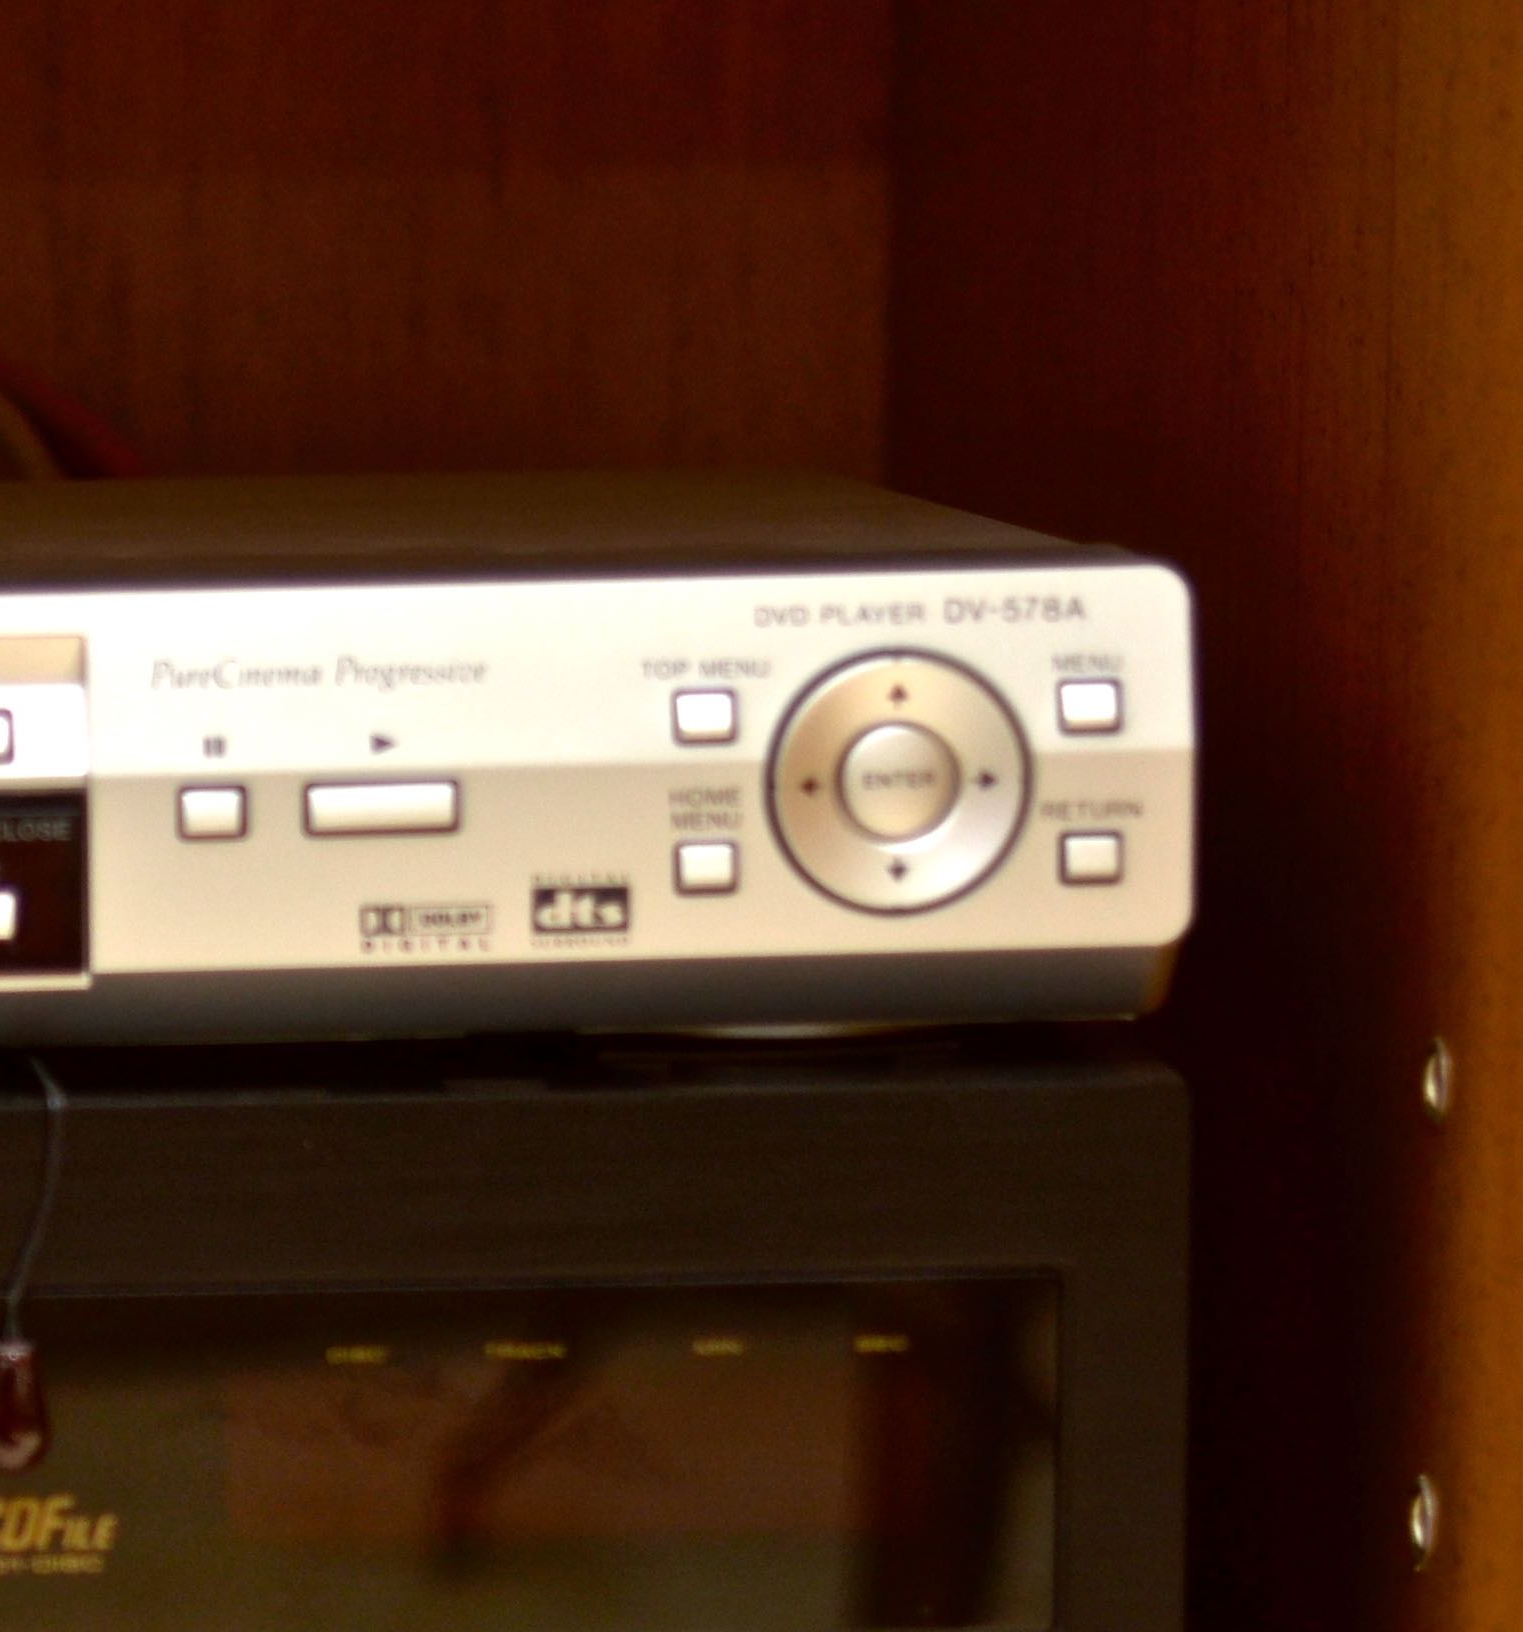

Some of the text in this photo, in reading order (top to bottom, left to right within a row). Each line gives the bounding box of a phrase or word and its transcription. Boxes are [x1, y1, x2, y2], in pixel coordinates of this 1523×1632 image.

[754, 596, 1087, 628] DVD PLAYER DV-578A
[334, 656, 489, 690] Progressive
[641, 657, 771, 680] TOP MENU
[1050, 654, 1124, 676] MENU
[861, 769, 934, 791] ENTER
[668, 787, 740, 810] HOME
[1037, 798, 1143, 822] RETURN
[670, 809, 741, 831] MENU
